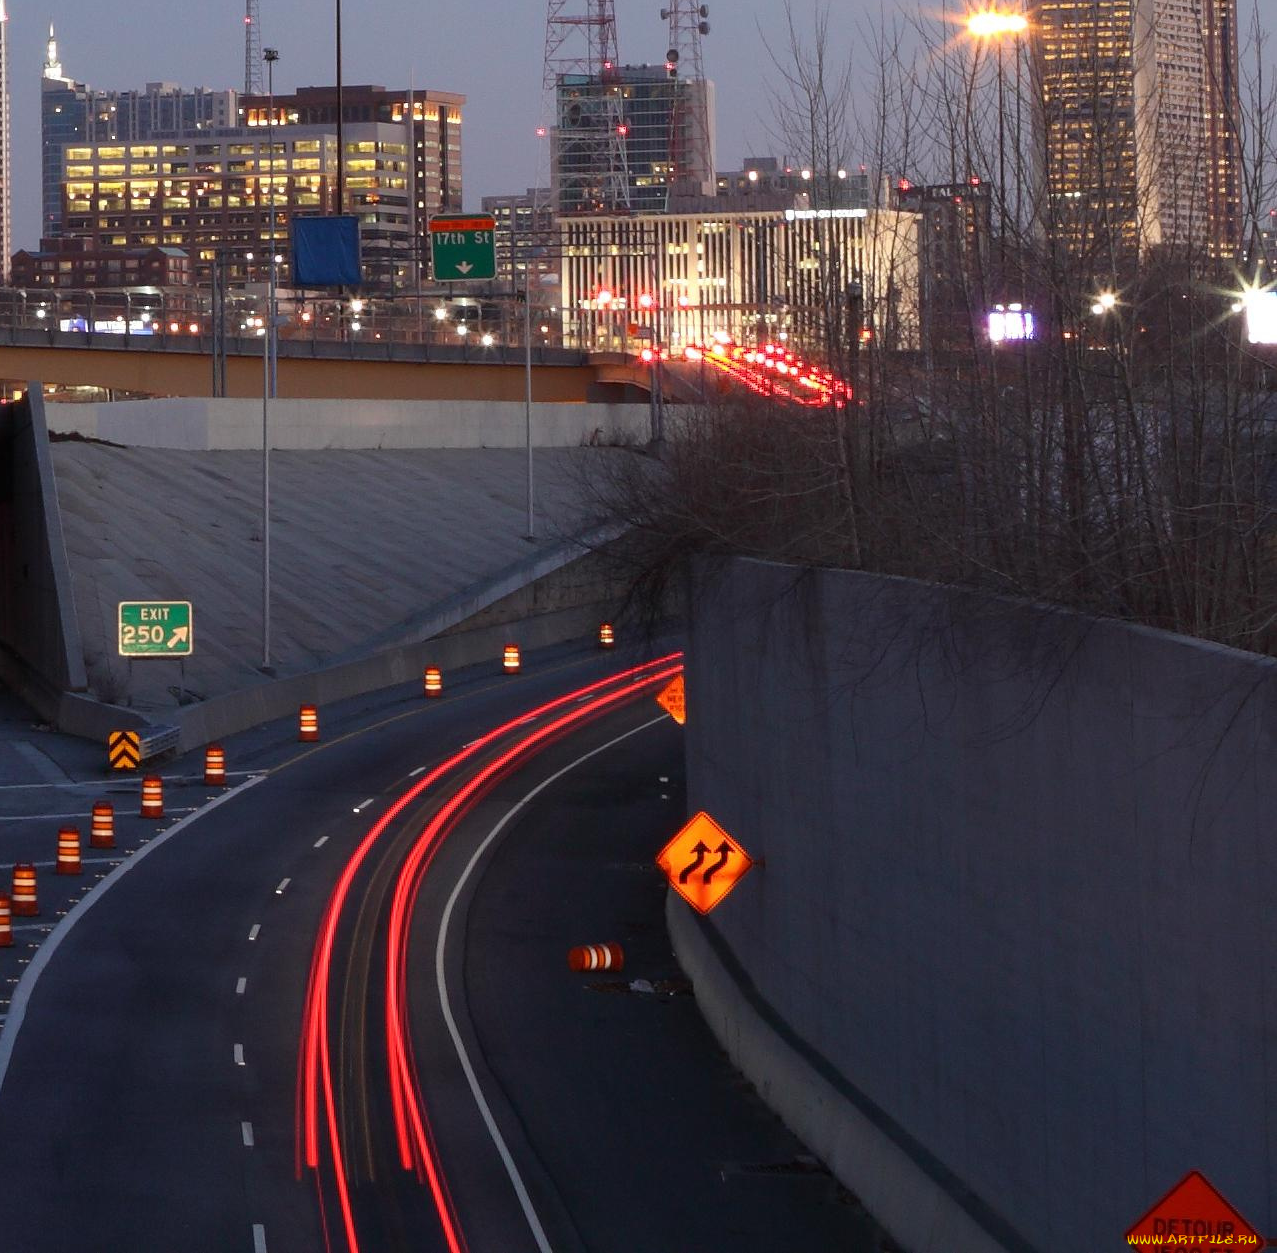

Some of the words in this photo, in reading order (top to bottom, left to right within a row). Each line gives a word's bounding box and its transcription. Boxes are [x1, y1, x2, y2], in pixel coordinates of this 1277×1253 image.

[436, 232, 465, 245] 17th
[474, 231, 490, 244] St
[141, 608, 170, 621] EXIT
[123, 625, 164, 645] 250
